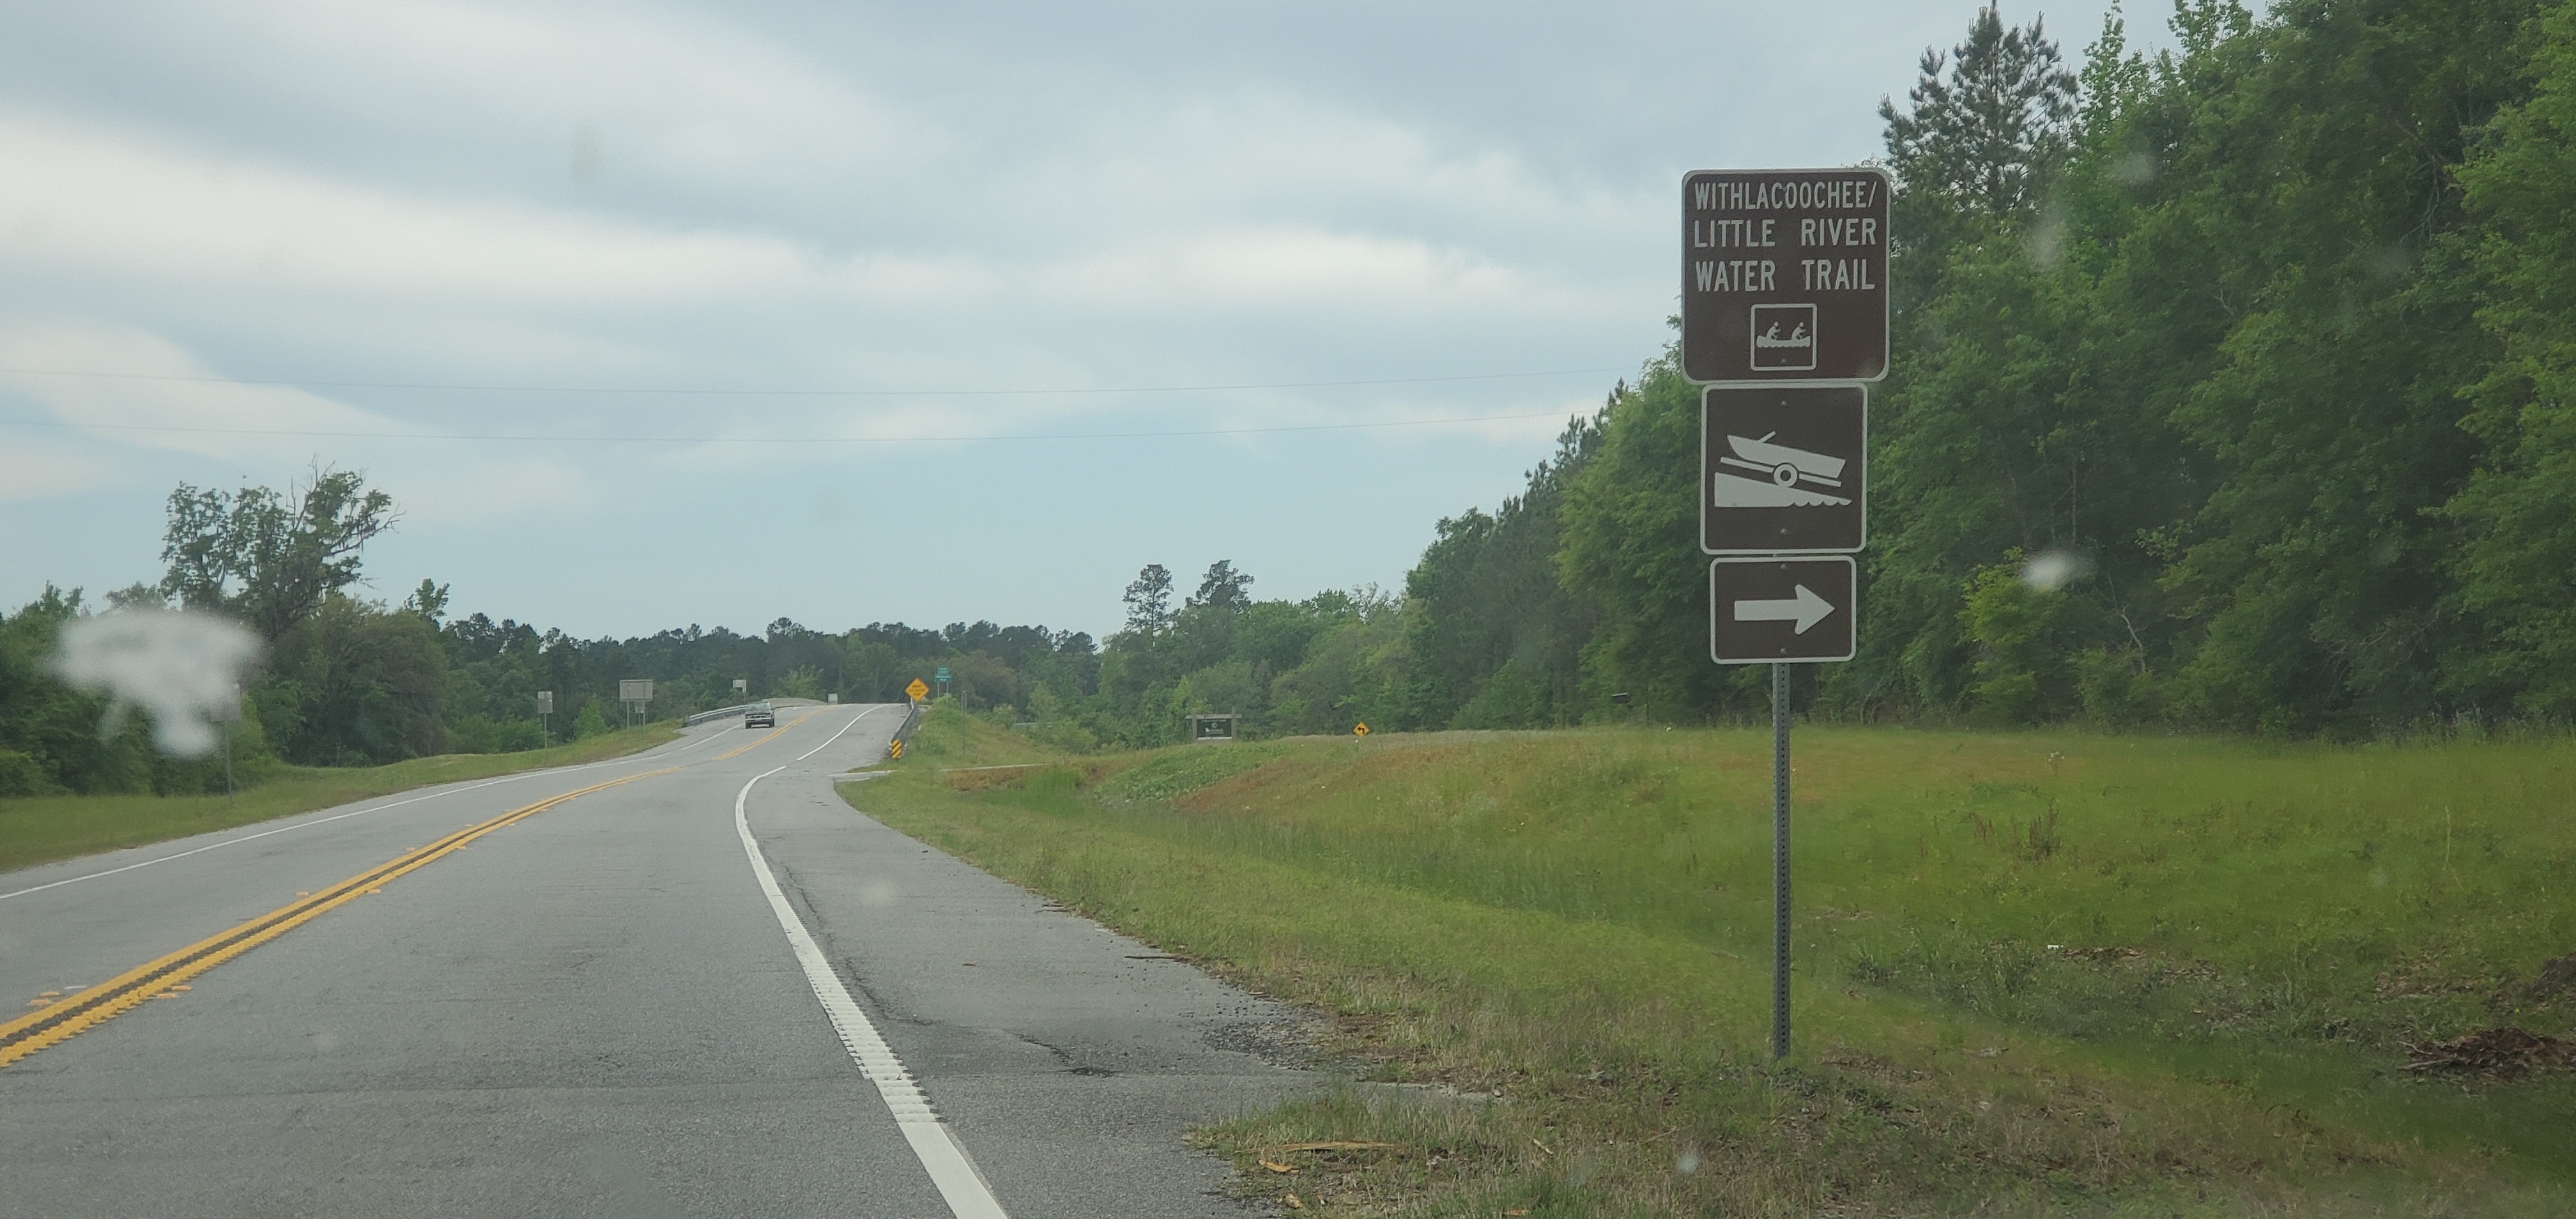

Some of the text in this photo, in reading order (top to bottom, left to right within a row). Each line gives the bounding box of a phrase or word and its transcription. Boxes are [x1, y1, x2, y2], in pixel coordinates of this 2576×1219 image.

[1695, 180, 1877, 210] WITHLACOOCHEE/
[1694, 218, 1877, 248] LITTLE RIVER
[1696, 259, 1875, 292] WATER TRAIL
